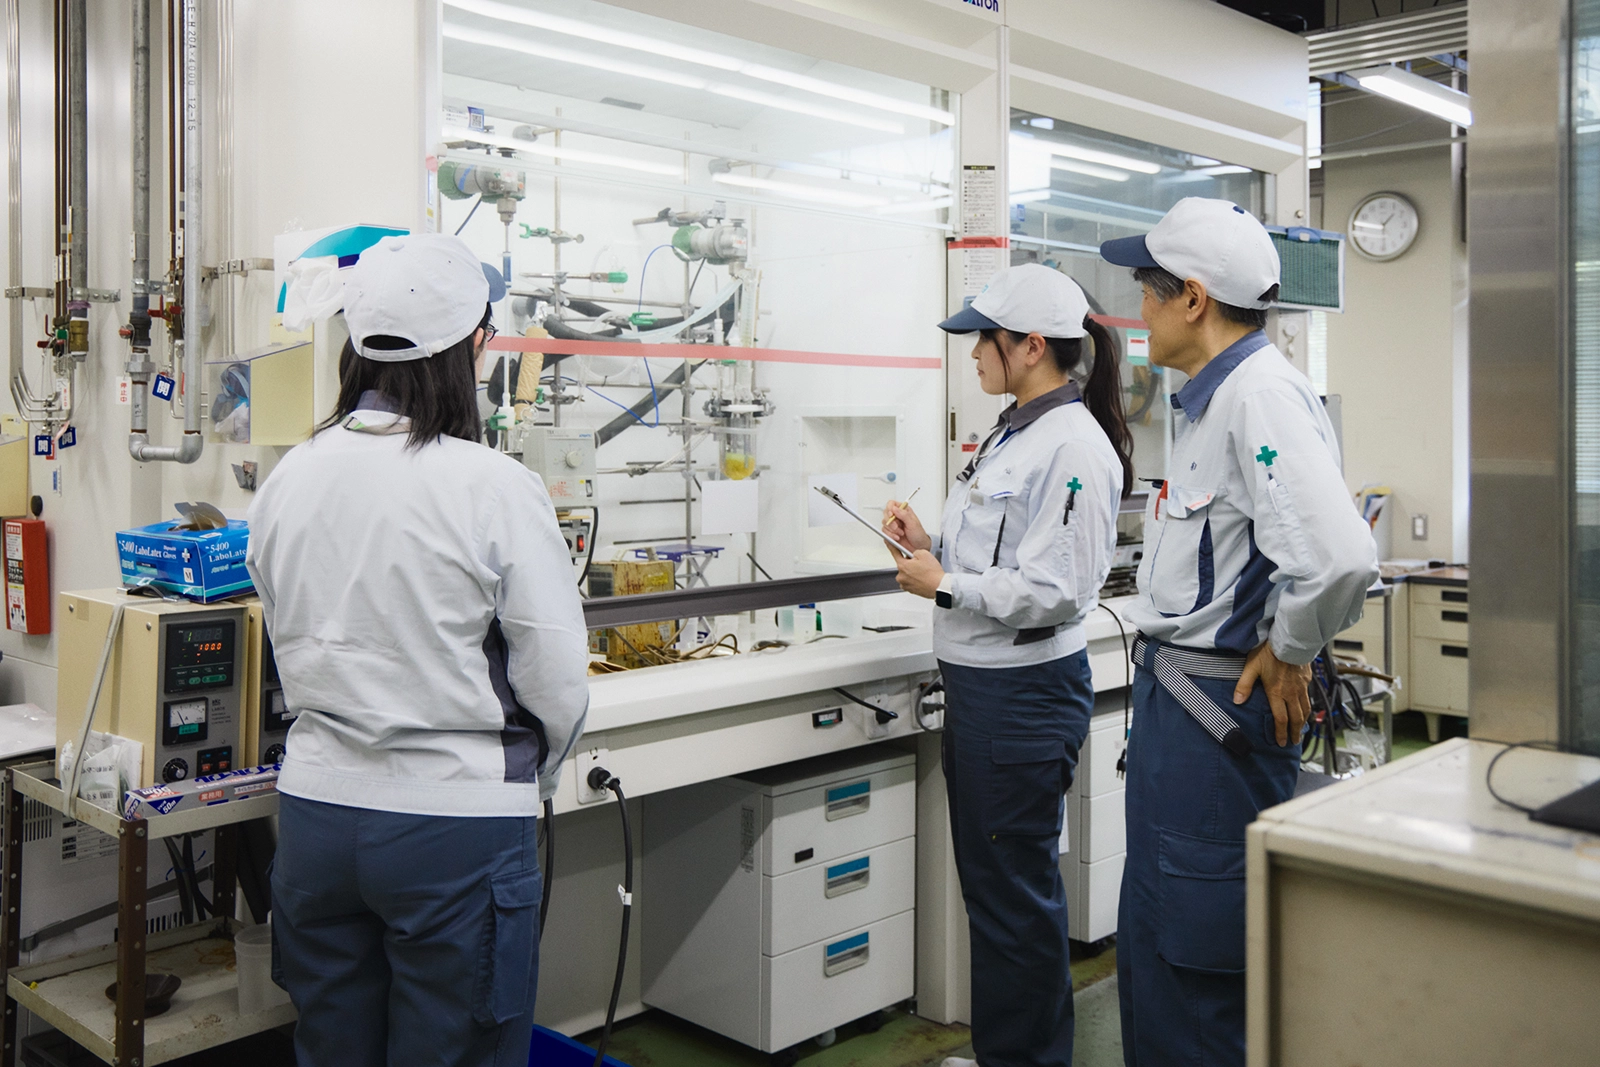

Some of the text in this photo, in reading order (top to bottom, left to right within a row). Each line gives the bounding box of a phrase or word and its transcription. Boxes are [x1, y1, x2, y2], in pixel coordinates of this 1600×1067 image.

[209, 549, 247, 563] LaboLate
[185, 572, 192, 581] M
[201, 790, 223, 800] 業務用
[162, 800, 177, 814] 50m
